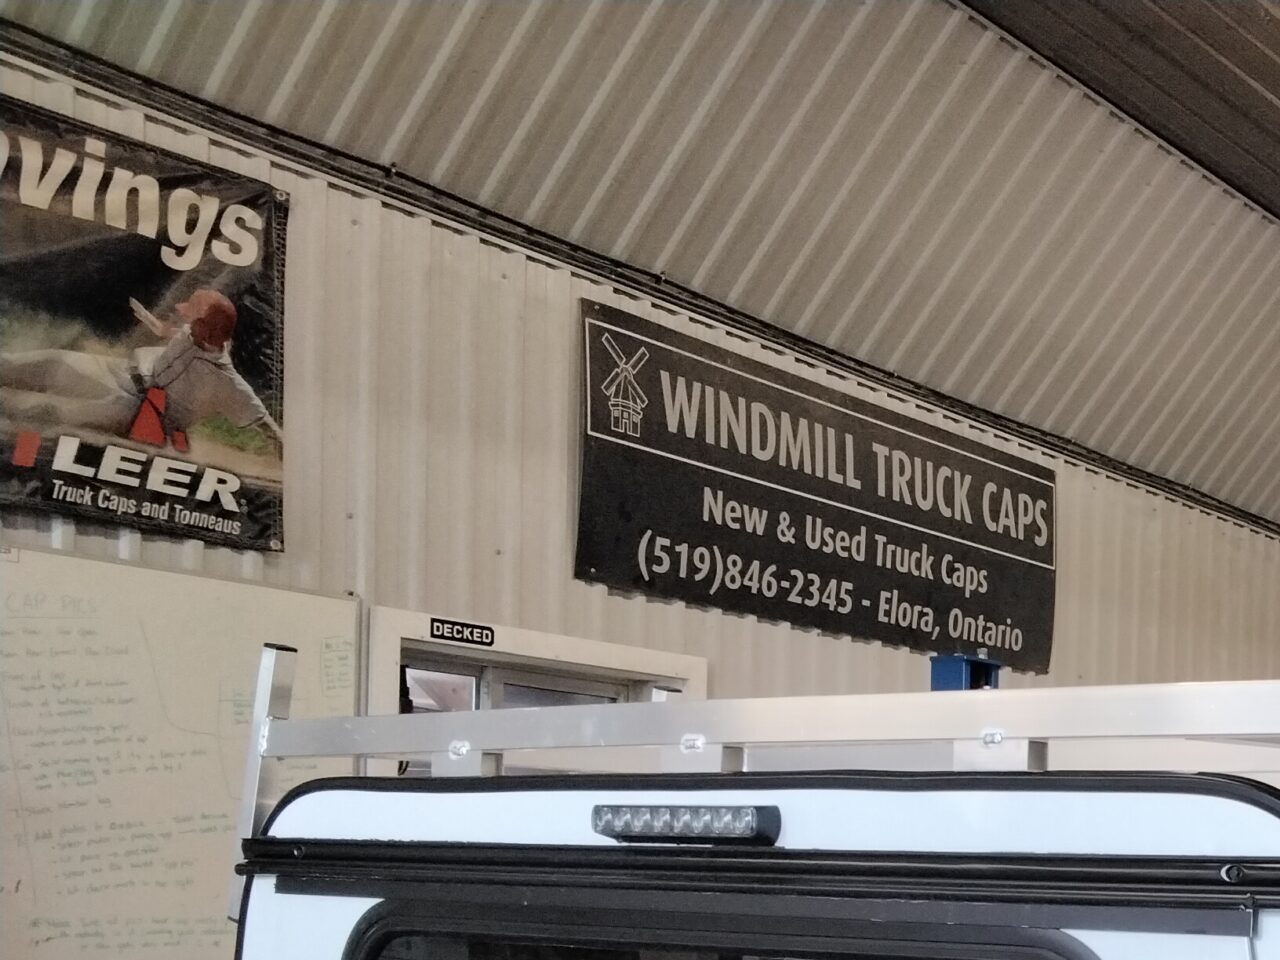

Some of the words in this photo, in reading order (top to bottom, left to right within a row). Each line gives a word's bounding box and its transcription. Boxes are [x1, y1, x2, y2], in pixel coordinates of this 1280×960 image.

[0, 129, 262, 271] vings
[52, 435, 241, 513] LEER
[52, 479, 93, 507] Truck
[97, 487, 137, 516] Caps
[141, 498, 169, 521] and
[174, 504, 241, 535] Tonneaus
[659, 369, 862, 490] WINDMILL
[871, 442, 972, 524] TRUCK
[982, 481, 1047, 548] CAPS
[637, 529, 853, 615] (519)846-2345
[877, 590, 940, 640] Elora,
[948, 608, 1023, 652] Ontario
[702, 486, 768, 535] New
[776, 511, 796, 544] &
[805, 515, 866, 562] Used
[874, 534, 934, 581] Truck
[940, 554, 988, 598] Caps
[433, 622, 492, 643] DECKED
